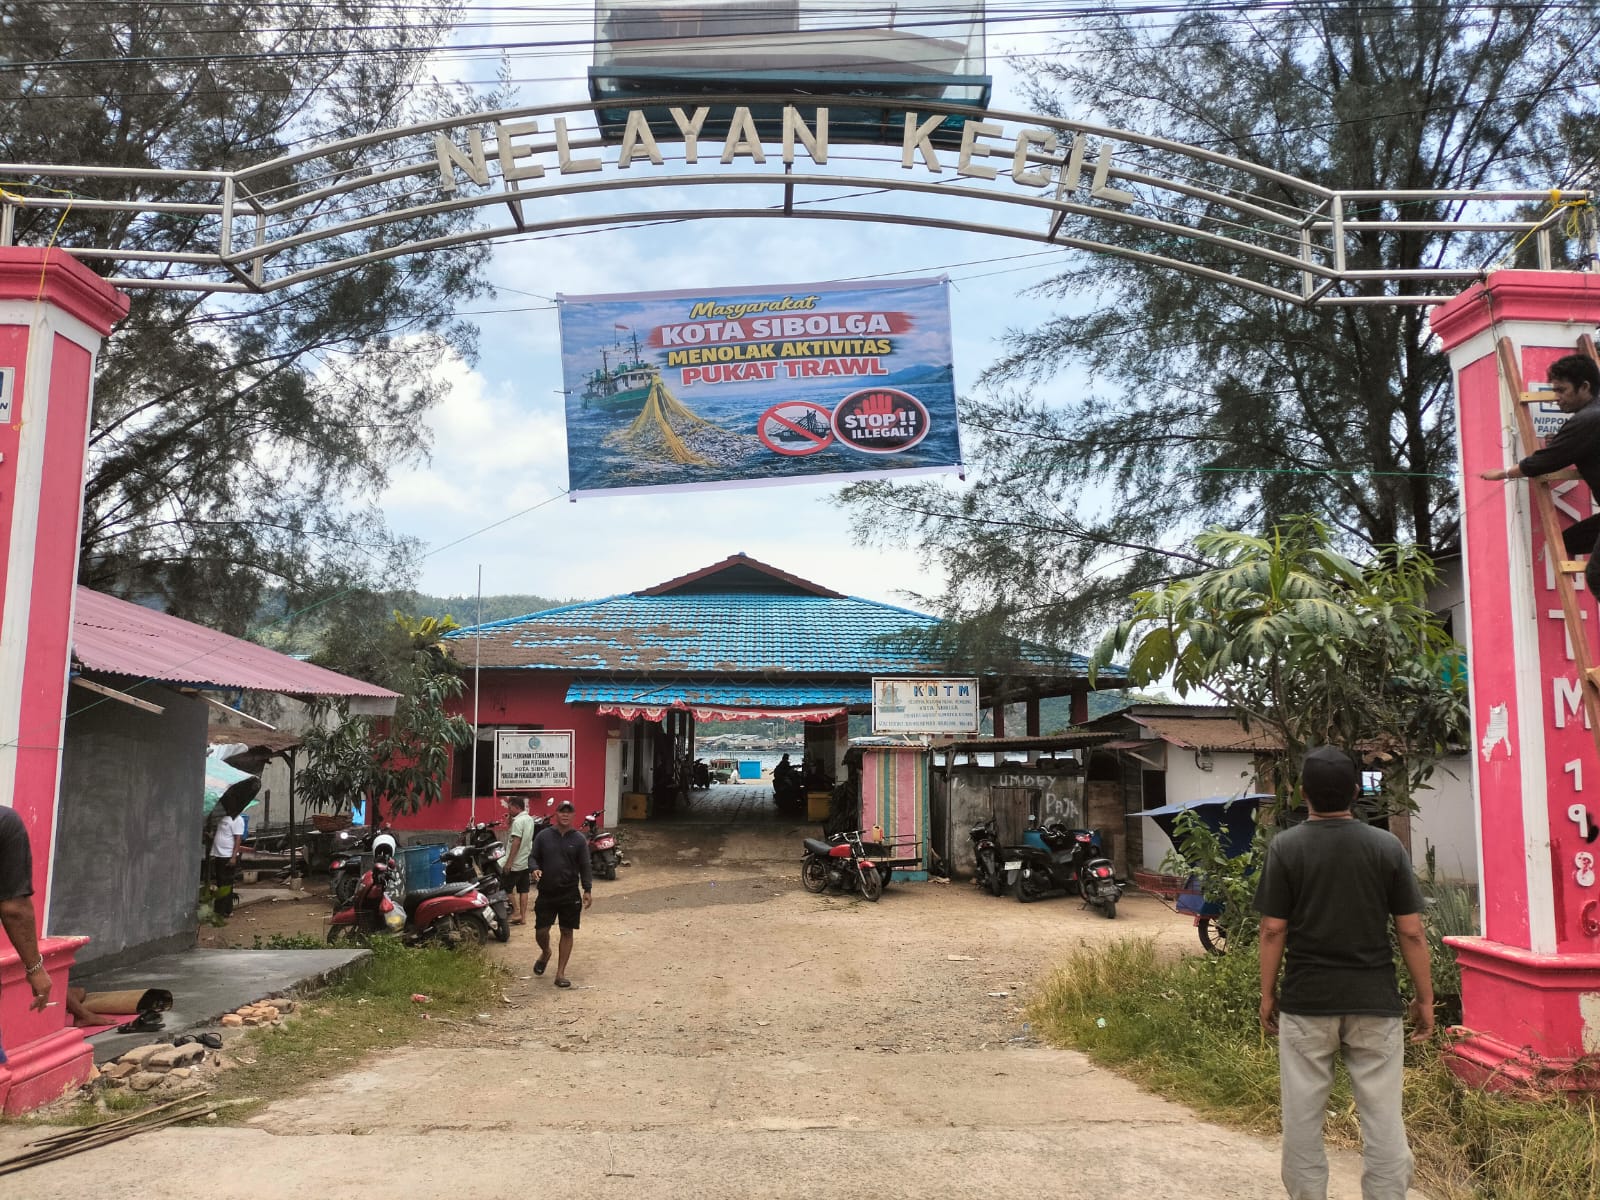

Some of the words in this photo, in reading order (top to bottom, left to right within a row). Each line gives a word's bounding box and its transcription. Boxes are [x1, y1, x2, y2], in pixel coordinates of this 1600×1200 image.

[436, 106, 829, 191] NELAYAN
[902, 112, 1134, 205] KECIL
[690, 296, 818, 319] Masyarakat
[661, 321, 745, 345] KOTA
[752, 313, 891, 338] SIBOLGA
[668, 344, 777, 367] MENOLAK
[780, 340, 891, 357] AKTIVITAS
[681, 361, 779, 386] PUKAT
[783, 358, 888, 378] TRAWL
[844, 413, 896, 428] STOP
[851, 426, 914, 439] ILLEGAL!
[913, 685, 970, 697] KNTM
